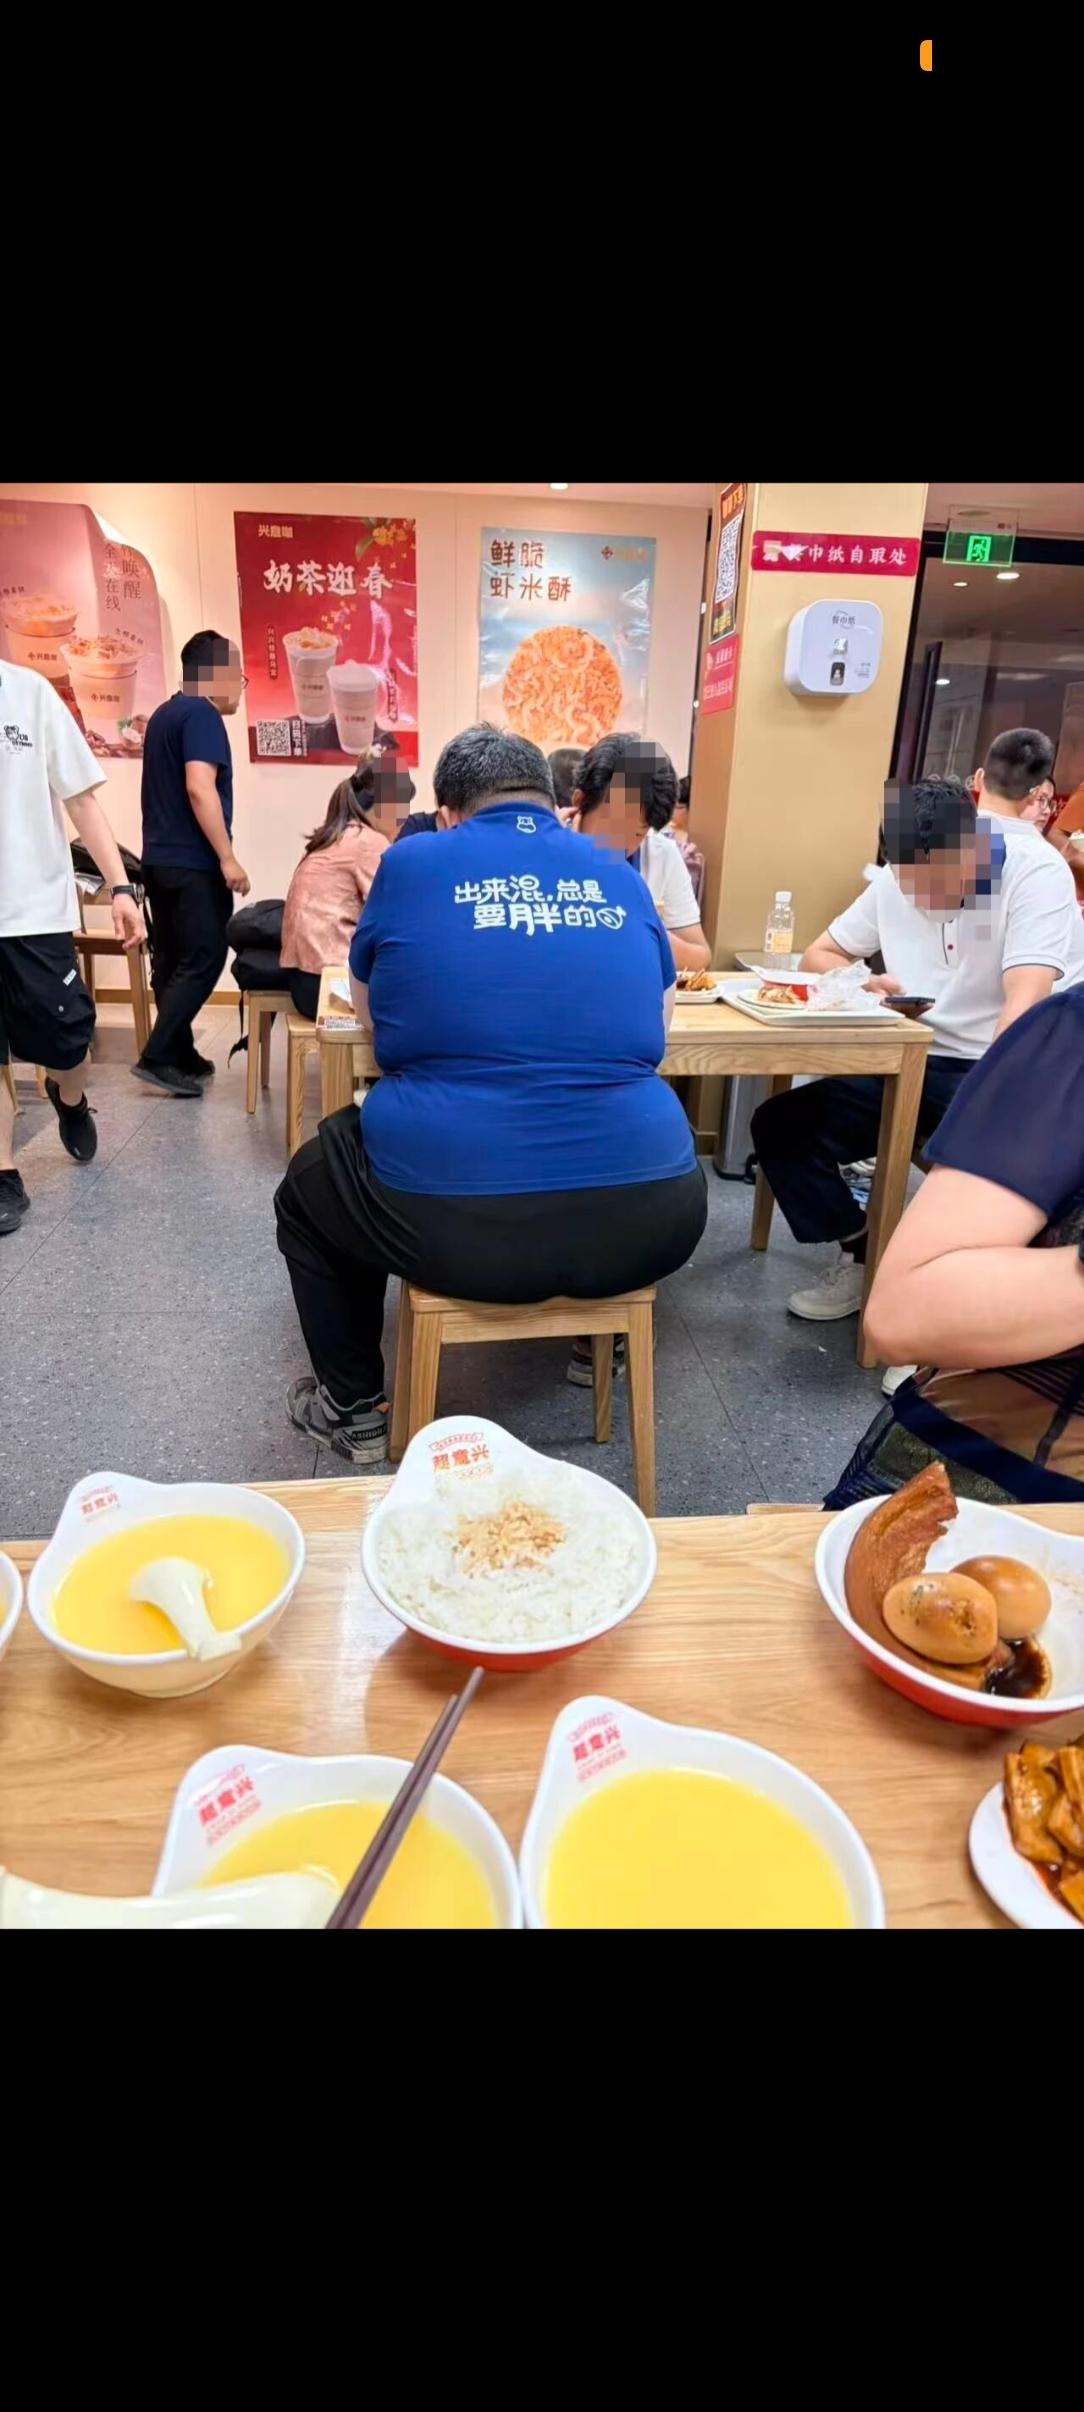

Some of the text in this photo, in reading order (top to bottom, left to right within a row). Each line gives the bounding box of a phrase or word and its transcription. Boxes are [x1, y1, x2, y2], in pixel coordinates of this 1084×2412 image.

[490, 539, 545, 568] 鲜脆
[490, 572, 571, 601] 虾米酥
